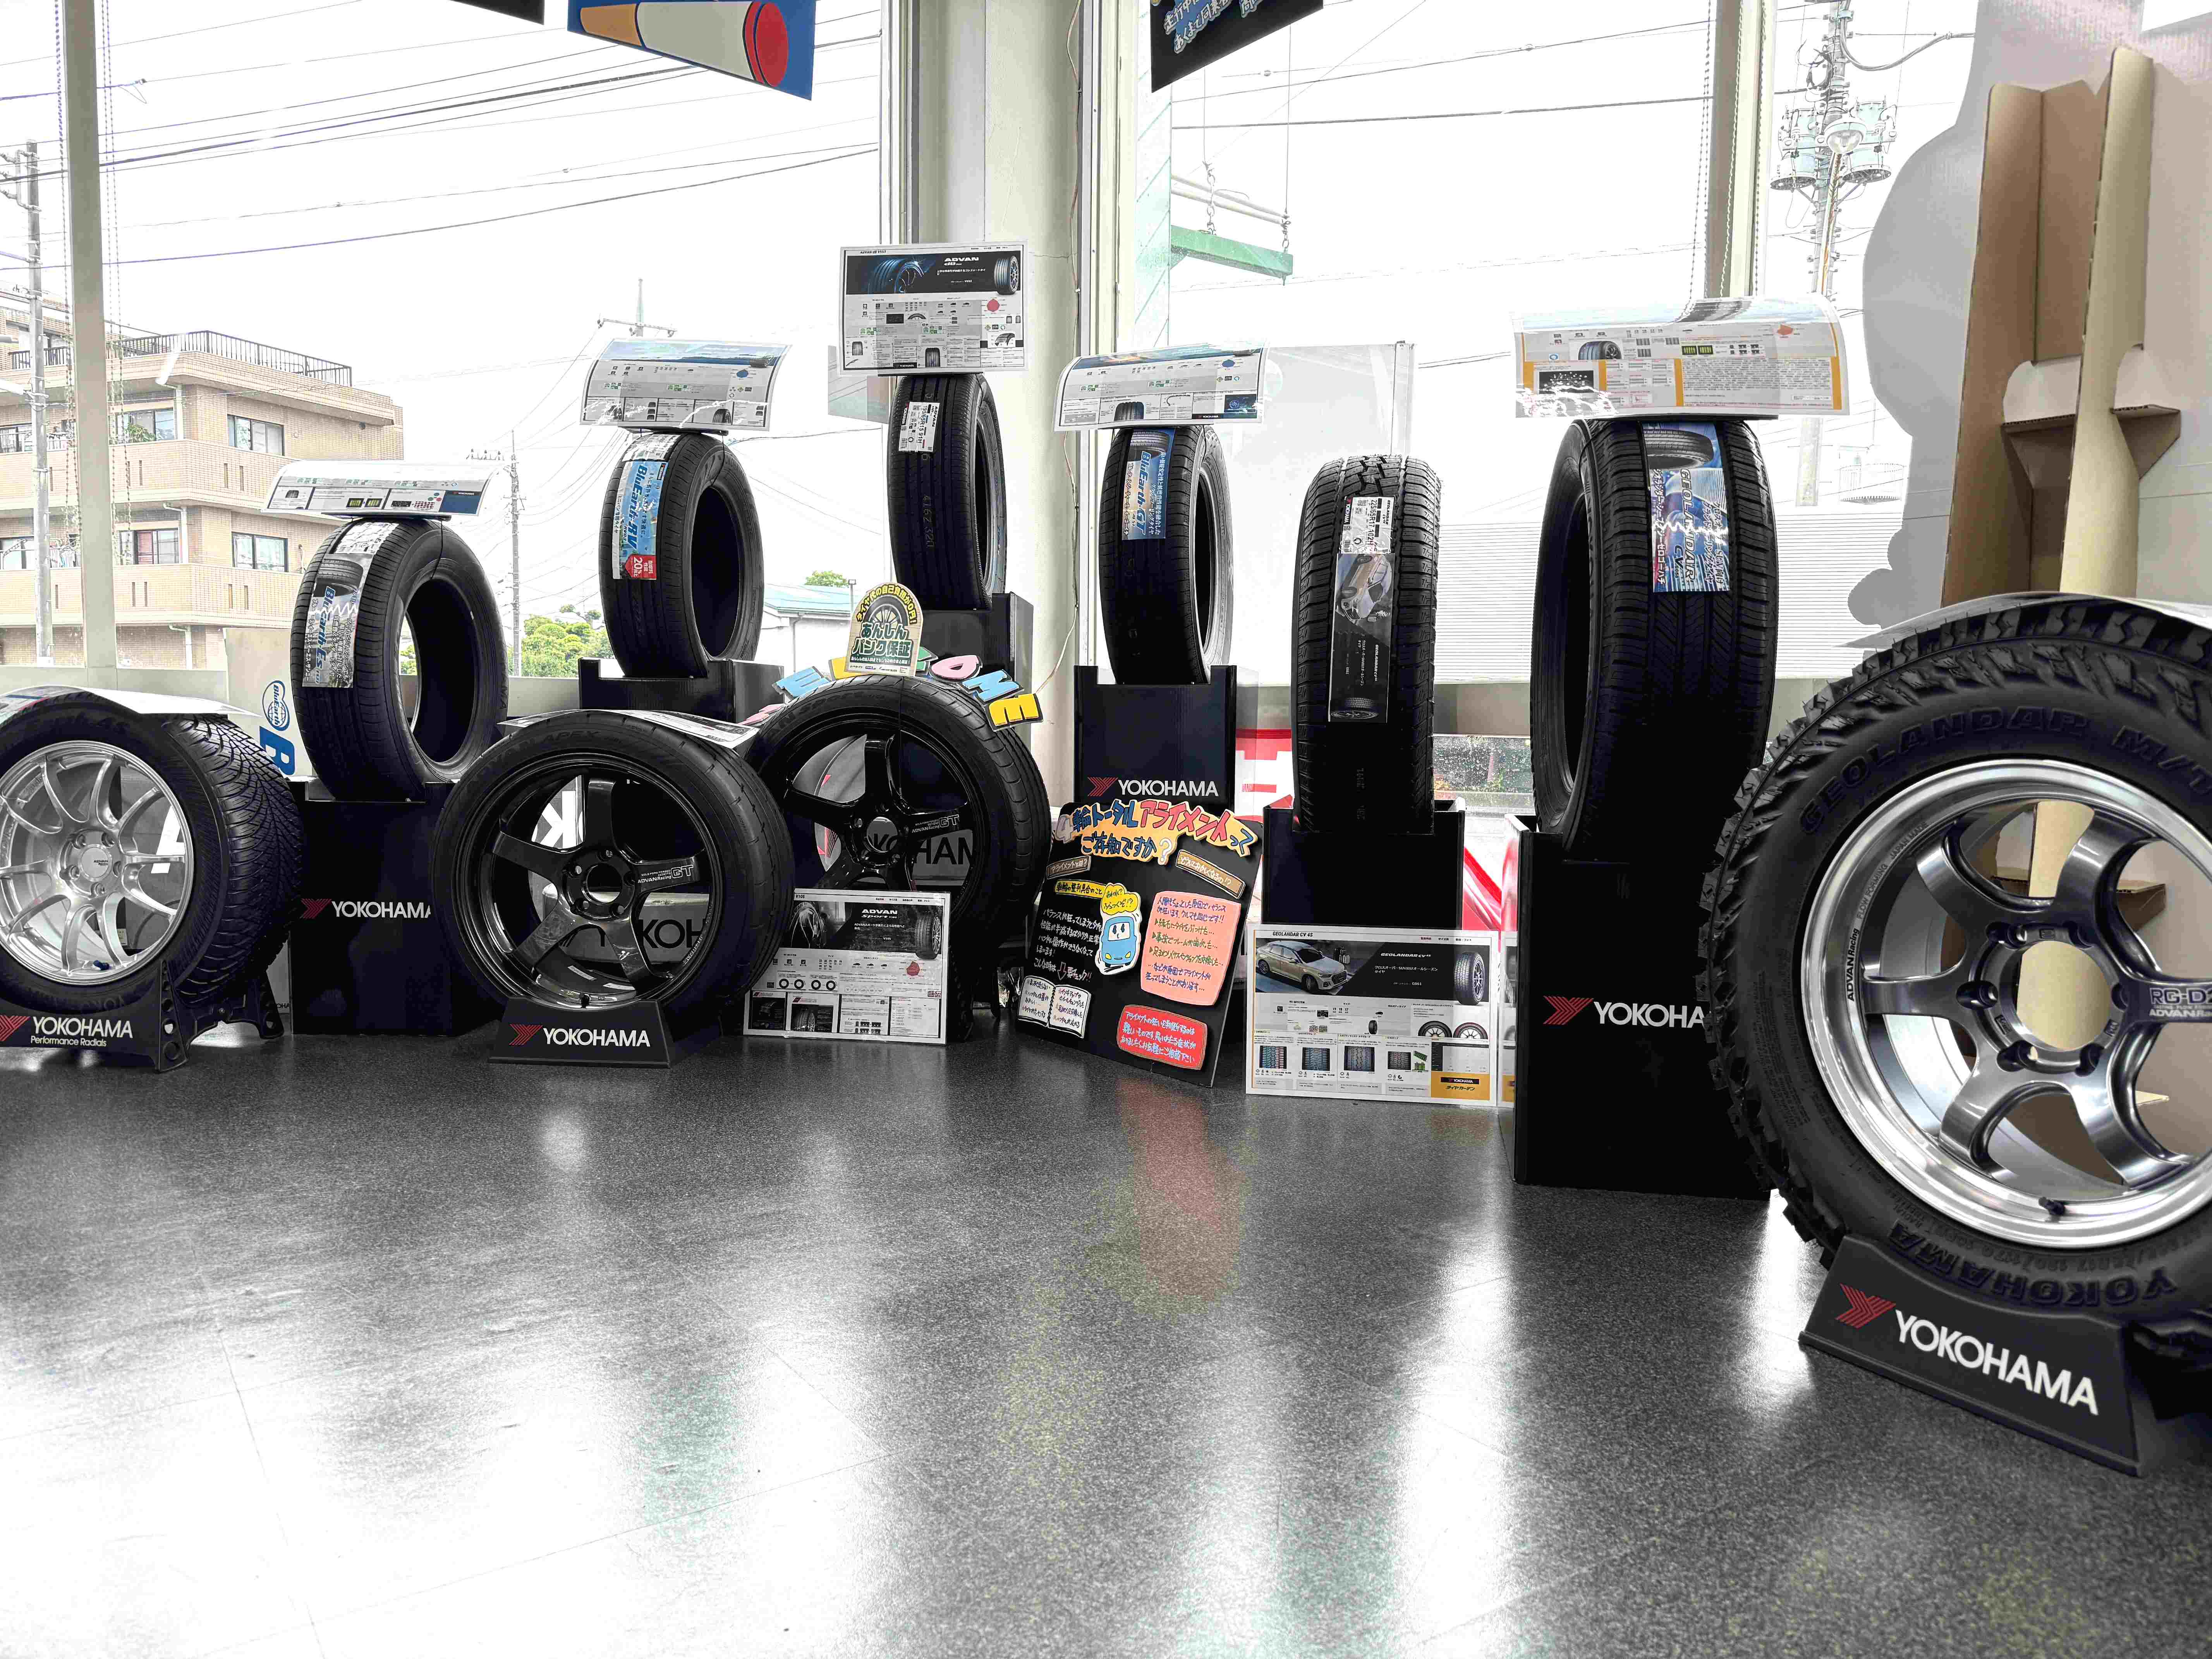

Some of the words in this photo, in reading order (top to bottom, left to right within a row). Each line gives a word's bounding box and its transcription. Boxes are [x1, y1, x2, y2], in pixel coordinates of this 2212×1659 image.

[919, 405, 927, 431] 195/65R15
[1136, 451, 1151, 535] BluEarth-GT
[627, 465, 648, 549] BluEarth-RV
[1369, 500, 1377, 527] 225/65R17
[860, 622, 909, 640] あんしん
[852, 638, 914, 658] パンク保証
[1798, 706, 2090, 835] GEOLANDAR
[1118, 780, 1219, 797] YOKOHAMA
[939, 814, 959, 828] GT
[1083, 831, 1172, 862] ご存知ですか?
[671, 864, 694, 878] GT
[1848, 928, 1860, 957] Racing
[1846, 955, 1855, 1001] ADVAN
[1593, 1001, 1705, 1029] YOKOHA
[2149, 1009, 2197, 1017] ADVAN
[32, 1016, 133, 1039] YOKOHAMA
[543, 1027, 651, 1047] YOKOHAMA
[30, 1035, 79, 1046] Performance
[80, 1037, 107, 1047] Radials
[1889, 1220, 2177, 1309] YOKOHAMA
[1896, 1309, 2099, 1415] YOKOHAMA
